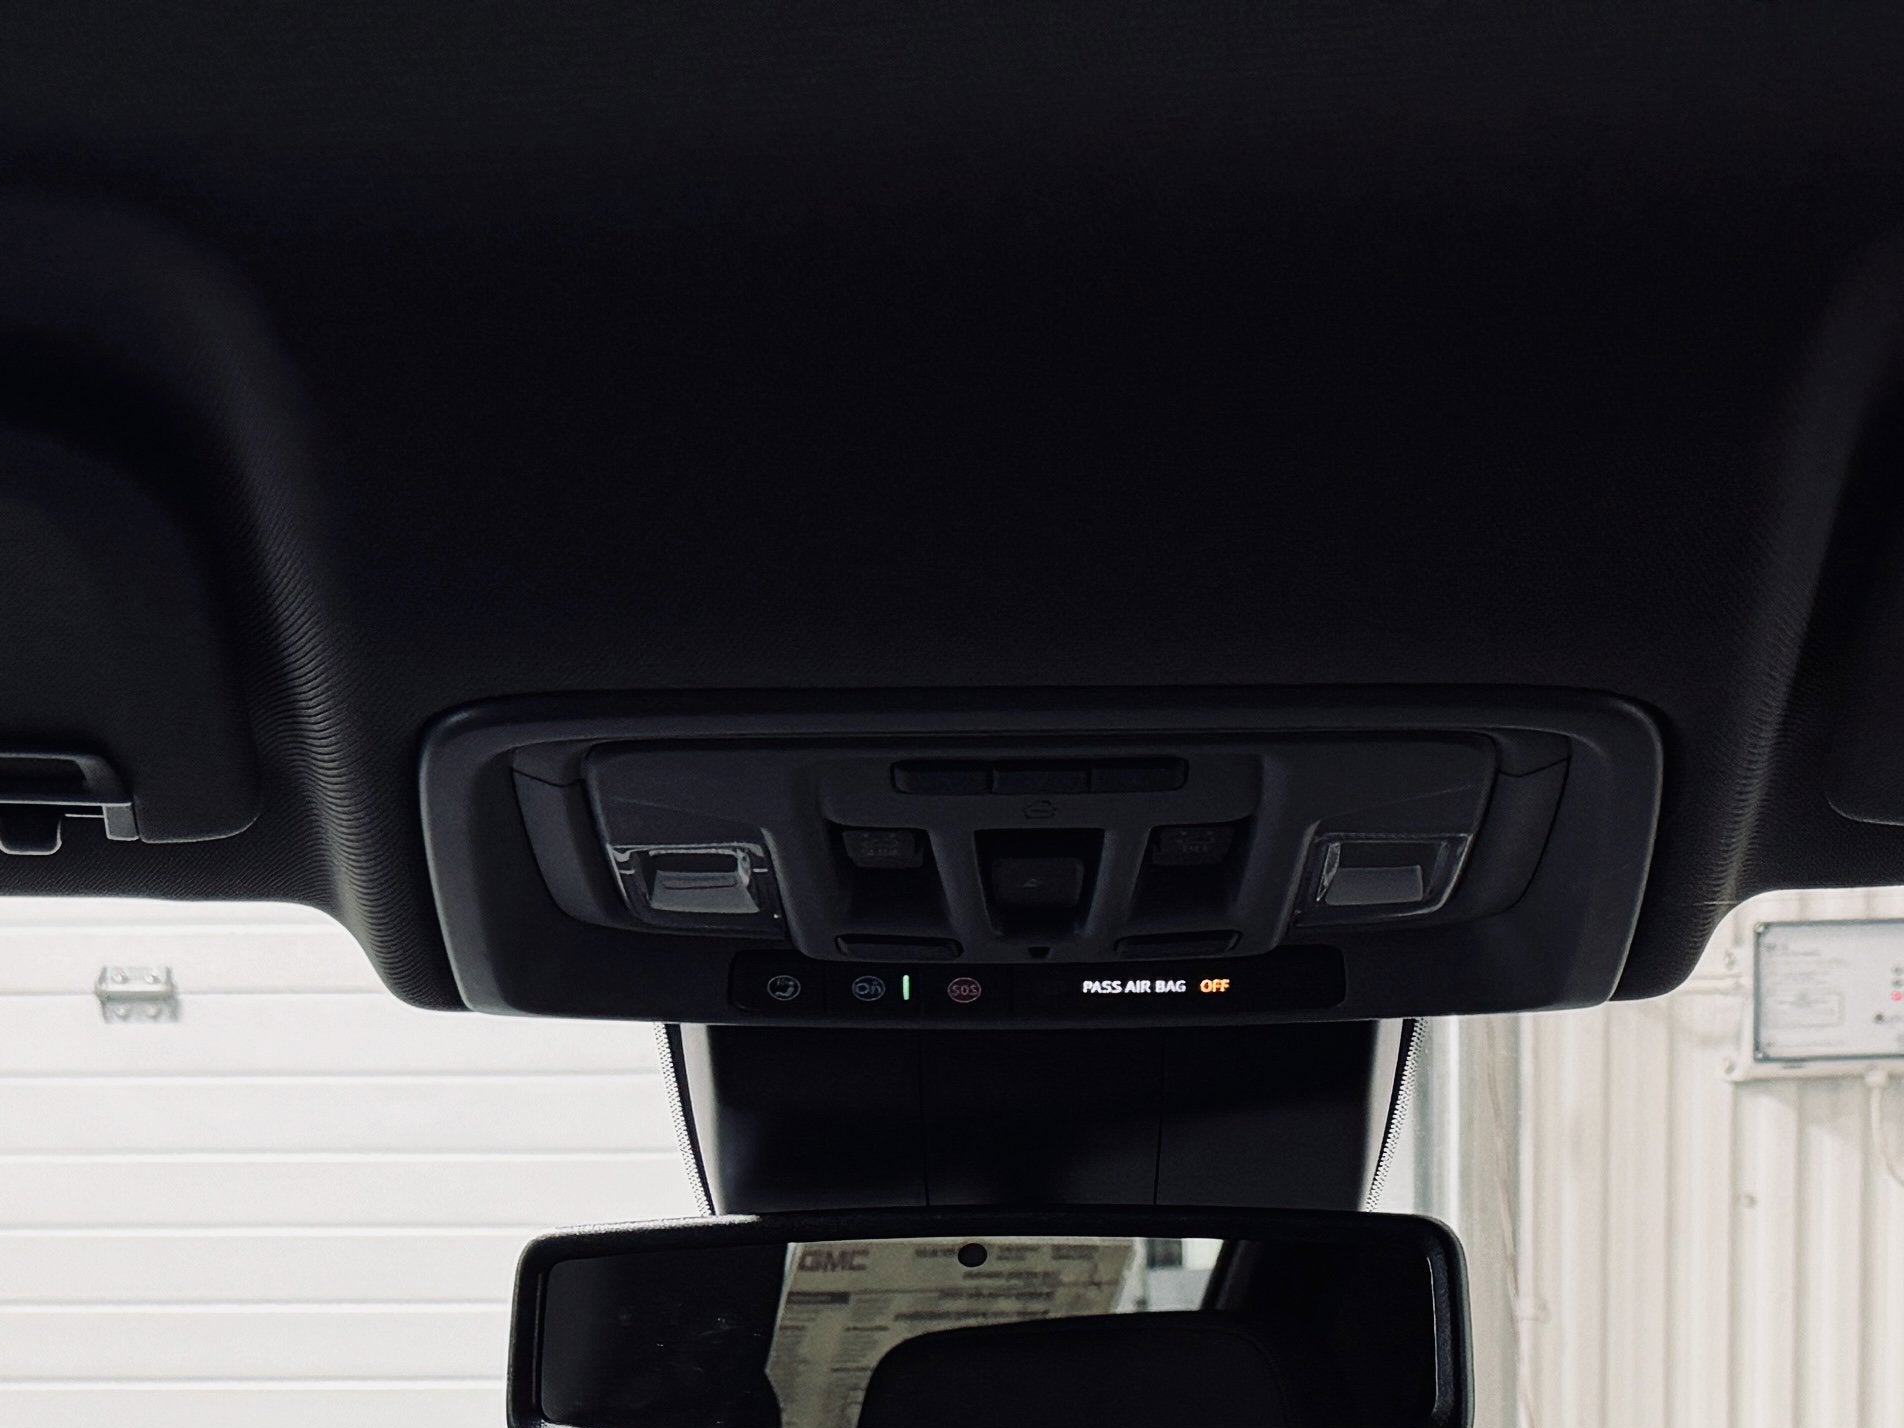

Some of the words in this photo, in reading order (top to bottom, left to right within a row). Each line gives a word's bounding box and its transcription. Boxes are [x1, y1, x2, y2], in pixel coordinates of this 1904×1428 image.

[952, 983, 978, 996] SOS
[1082, 979, 1121, 994] PASS
[1125, 979, 1151, 994] AIR
[1155, 979, 1186, 994] BAG
[1200, 979, 1230, 993] OFF
